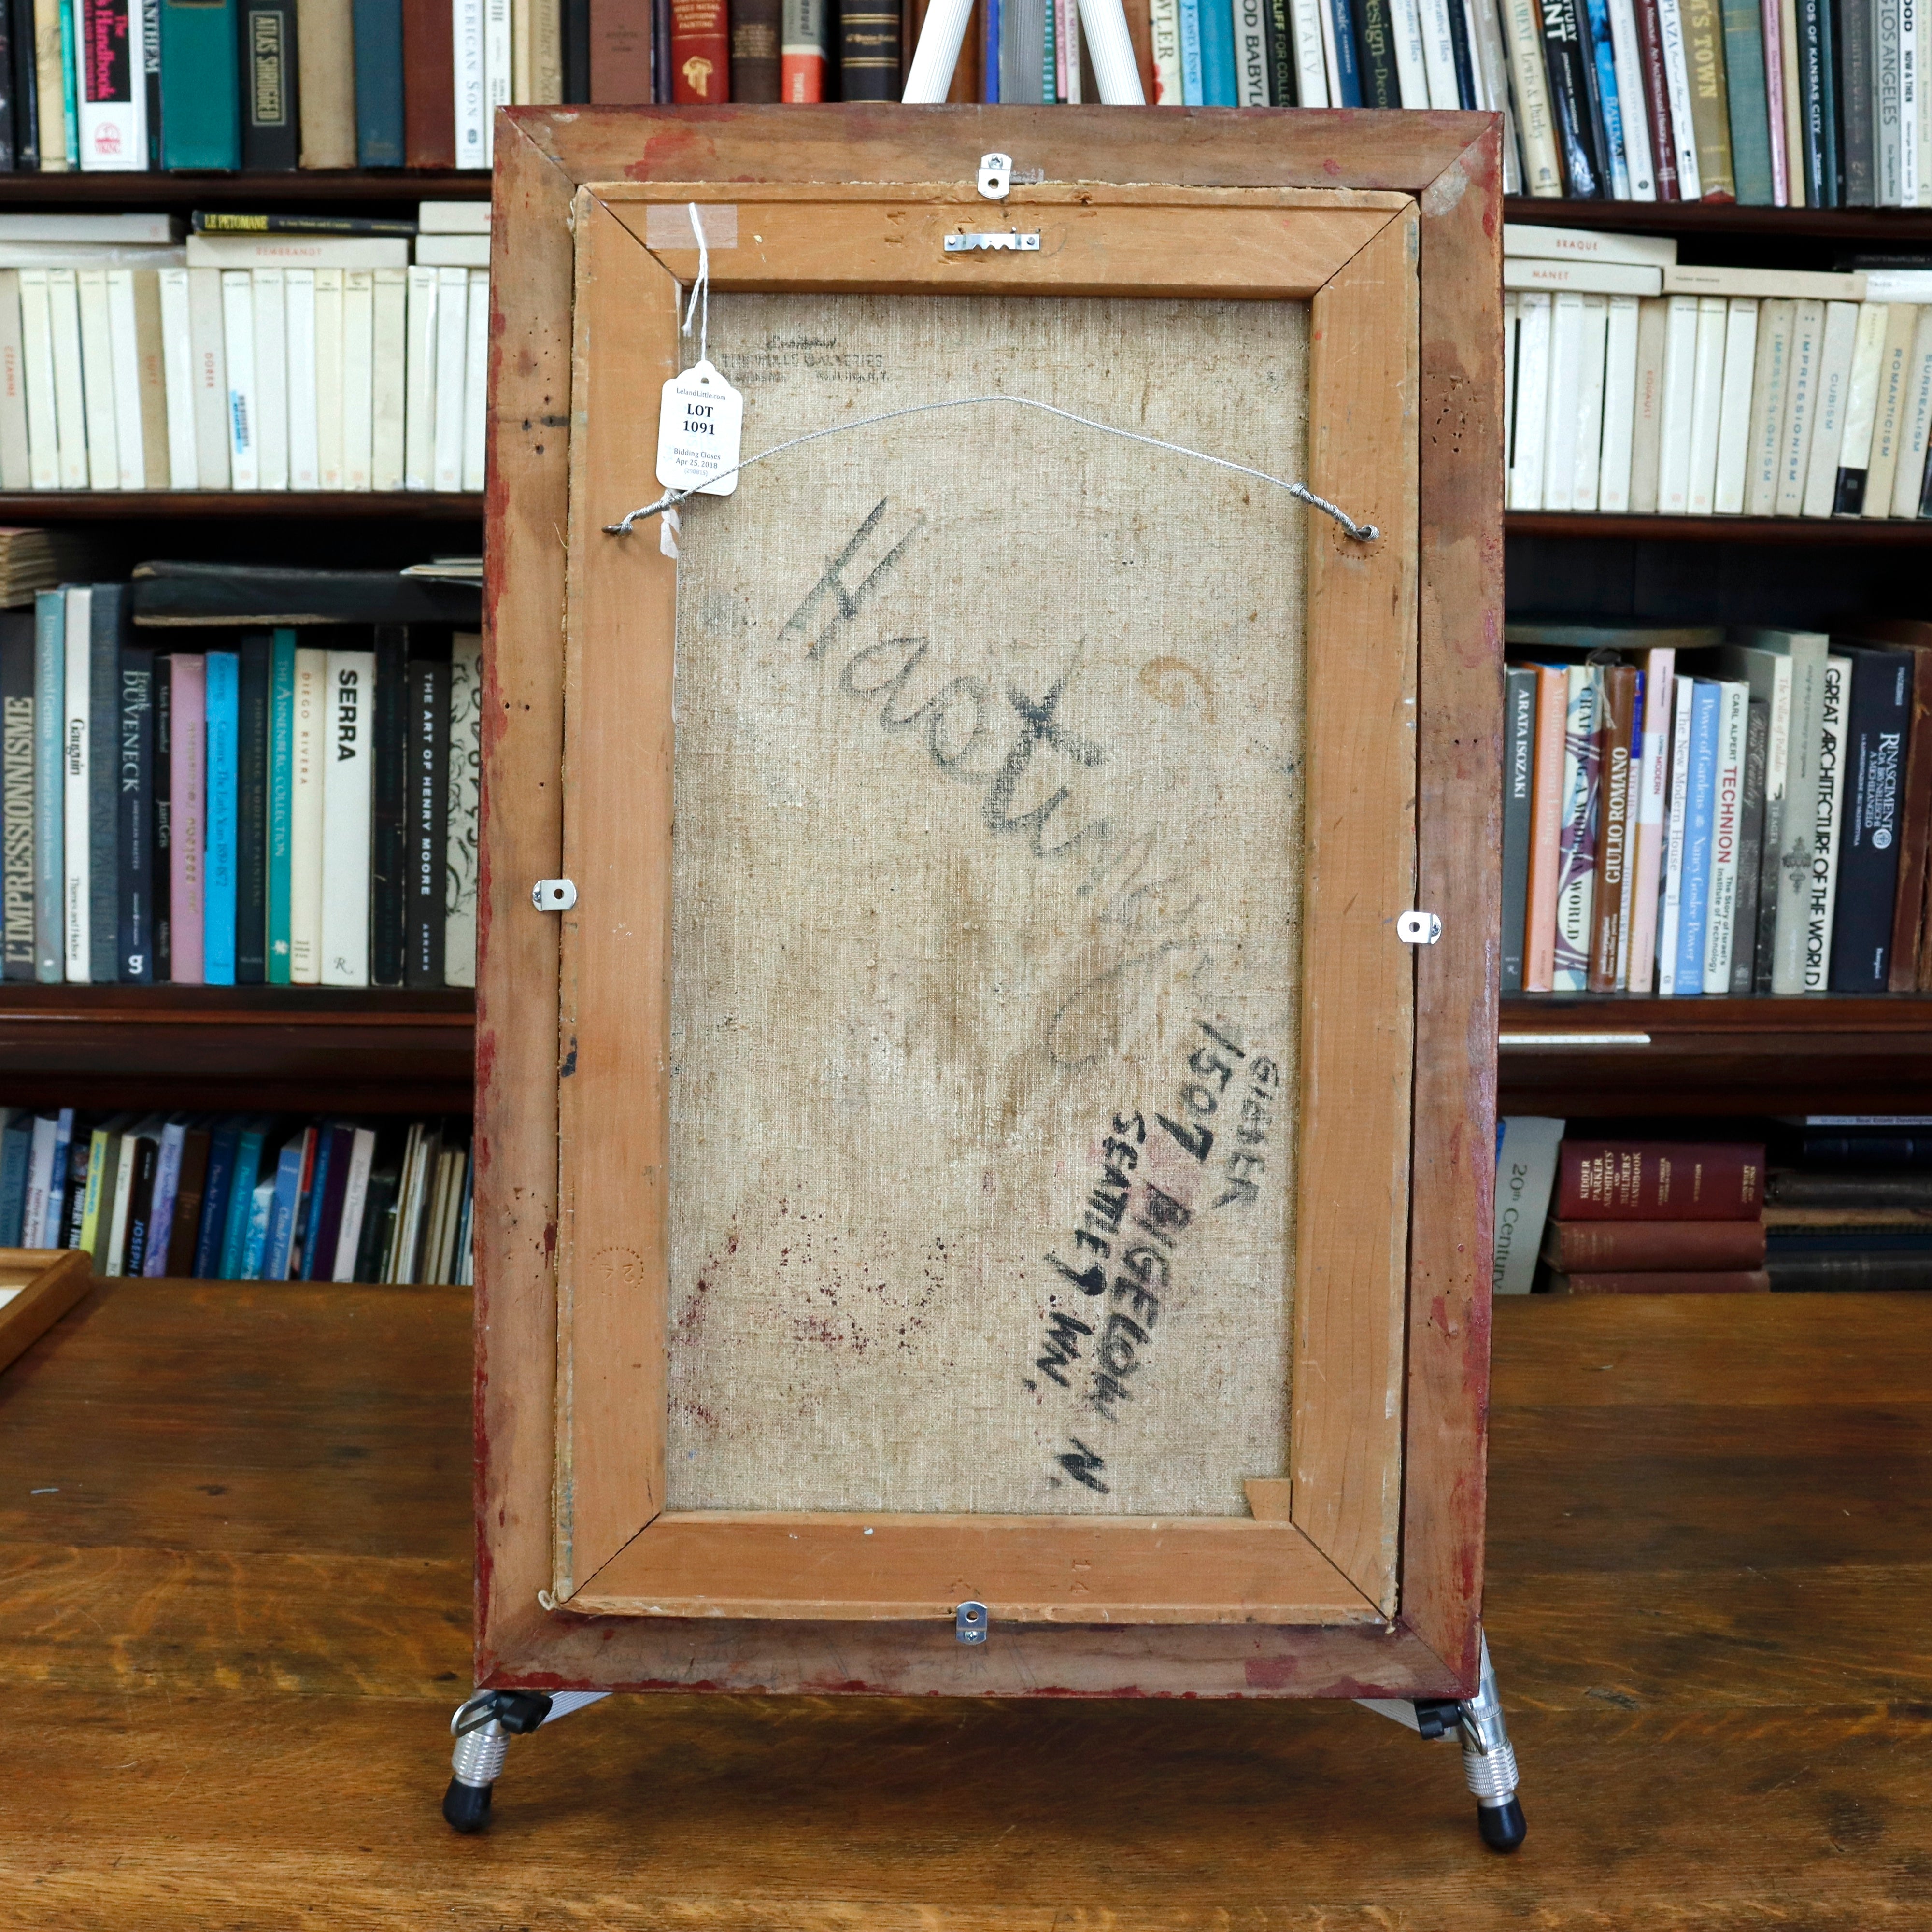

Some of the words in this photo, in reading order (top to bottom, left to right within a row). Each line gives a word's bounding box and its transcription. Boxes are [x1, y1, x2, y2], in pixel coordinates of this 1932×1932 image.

[256, 17, 278, 52] ATLAS
[1276, 34, 1287, 58] FOR
[1808, 26, 1817, 43] OF
[1882, 9, 1896, 41] LOS
[97, 10, 115, 99] Handbook
[1694, 34, 1718, 97] TOWN
[1809, 47, 1820, 100] KANSAS
[257, 56, 279, 119] SHRUGGED
[1883, 51, 1897, 125] ANGELES
[1812, 104, 1821, 134] CITY
[1556, 240, 1599, 251] BRAQUE
[1532, 270, 1570, 281] MANET
[677, 388, 725, 400] LelandLittle.com
[687, 403, 713, 417] LOT
[1762, 334, 1783, 482] IMPRESSIONISM
[1789, 334, 1810, 482] IMPRESSIONISM
[1825, 373, 1839, 430] CUBISM
[1882, 348, 1903, 457] ROMANTICISM
[1912, 354, 1932, 452] SURREALISM
[683, 420, 715, 435] 1091
[674, 448, 699, 458] Bidding
[700, 452, 721, 460] Closes
[138, 671, 151, 711] Frank
[301, 673, 311, 719] DIEGO
[424, 673, 432, 703] THE
[1732, 694, 1740, 719] CARL
[1823, 669, 1841, 724] GREAT
[122, 670, 140, 792] DUVENECK
[337, 669, 358, 762] SERRA
[423, 710, 432, 743] ART
[1517, 689, 1530, 737] ARATA
[1678, 709, 1690, 734] The
[1700, 698, 1714, 737] Power
[66, 718, 85, 775] Gauguin
[300, 731, 309, 785] RIVERA
[423, 750, 432, 770] OF
[1676, 740, 1688, 767] New
[1700, 741, 1714, 755] of
[1729, 724, 1738, 761] ALPERT
[1514, 740, 1528, 798] ISOZAKI
[1608, 747, 1628, 821] ROMANO
[1654, 756, 1662, 795] MODERN
[1695, 756, 1712, 810] Gardens
[1815, 728, 1837, 855] ARCHITECTURE
[422, 777, 432, 831] HENRY
[1673, 774, 1685, 823] Modern
[1718, 766, 1738, 863] TECHNION
[1865, 761, 1877, 828] MICHELANGELO
[3, 697, 34, 963] L'IMPRESSIONNISME
[1605, 825, 1623, 883] GIULIO
[1669, 829, 1683, 871] House
[421, 838, 431, 895] MOORE
[1714, 868, 1724, 905] Institute
[1725, 876, 1733, 893] The
[1813, 858, 1829, 883] OF
[1567, 881, 1583, 940] WORLD
[1715, 908, 1722, 917] of
[1721, 896, 1732, 919] Story
[1810, 887, 1827, 915] THE
[1686, 922, 1701, 961] Power
[1709, 921, 1721, 973] Technology
[1720, 933, 1729, 966] Israel's
[1722, 922, 1730, 930] of
[1805, 920, 1825, 986] WORLD
[1154, 1018, 1246, 1162] 1507
[1074, 1110, 1148, 1259] SEATTLE
[1510, 1163, 1528, 1201] 20th
[1580, 1160, 1591, 1199] KIDDER
[1593, 1158, 1603, 1201] PARKER
[1604, 1150, 1614, 1208] ARCHITECTS'
[1621, 1153, 1631, 1204] BUILDERS'
[1631, 1152, 1641, 1207] HANDBOOK
[130, 1219, 144, 1270] JOSEPH
[1493, 1208, 1520, 1289] Century
